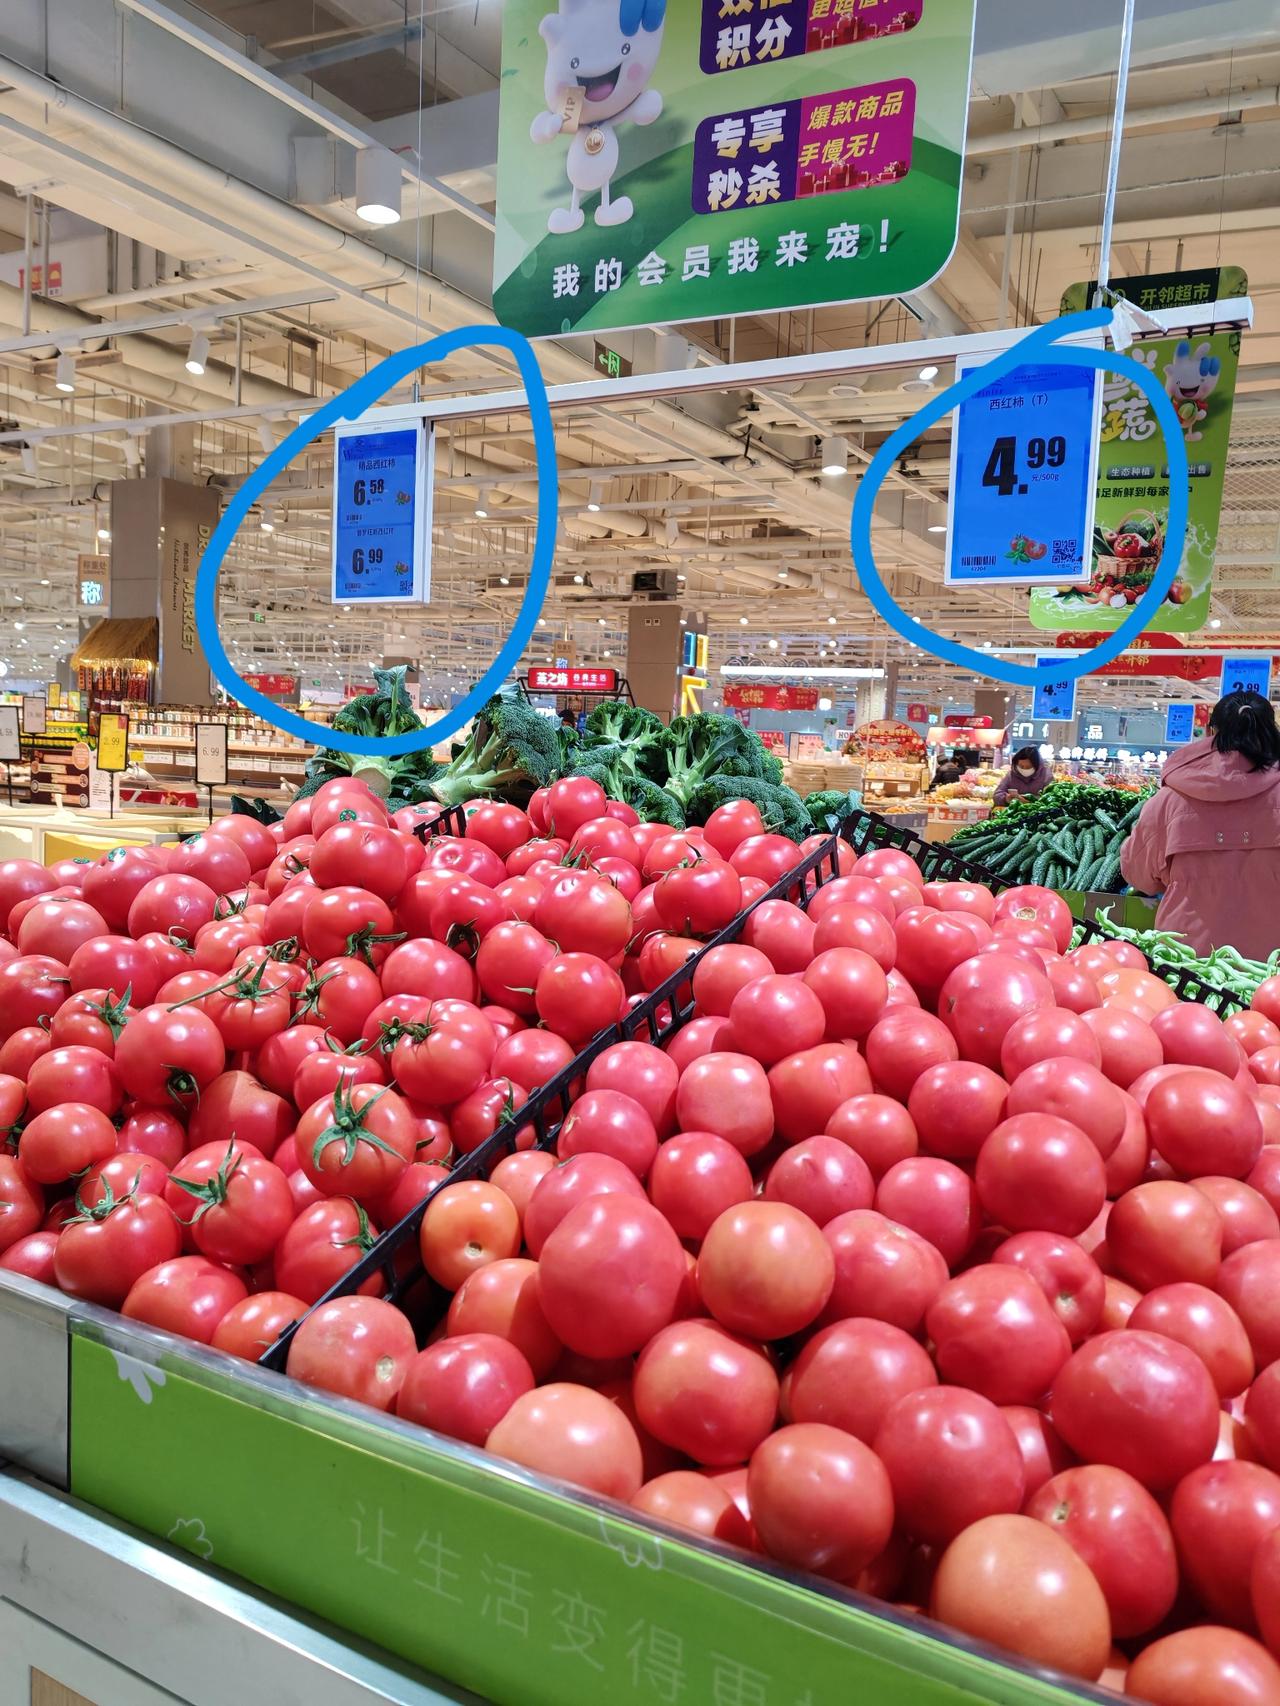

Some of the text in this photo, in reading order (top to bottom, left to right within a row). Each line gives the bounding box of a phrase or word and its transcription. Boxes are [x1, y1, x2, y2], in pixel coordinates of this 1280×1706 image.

[715, 15, 792, 70] 积分
[563, 96, 576, 122] VIP
[807, 89, 904, 132] 爆款商品
[711, 108, 787, 159] 专享
[707, 162, 783, 212] 秒杀
[1140, 283, 1211, 306] 开邻超市
[982, 436, 1067, 496] 4.99
[1111, 466, 1150, 477] 生态种植
[1166, 464, 1207, 475] 出售
[353, 479, 384, 506] 6.58
[1096, 486, 1193, 499] 足新鲜到每家
[352, 547, 384, 575] 6.99
[182, 577, 196, 654] MARKET
[202, 746, 220, 757] 6.99
[350, 1502, 814, 1706] 让生活变得更
